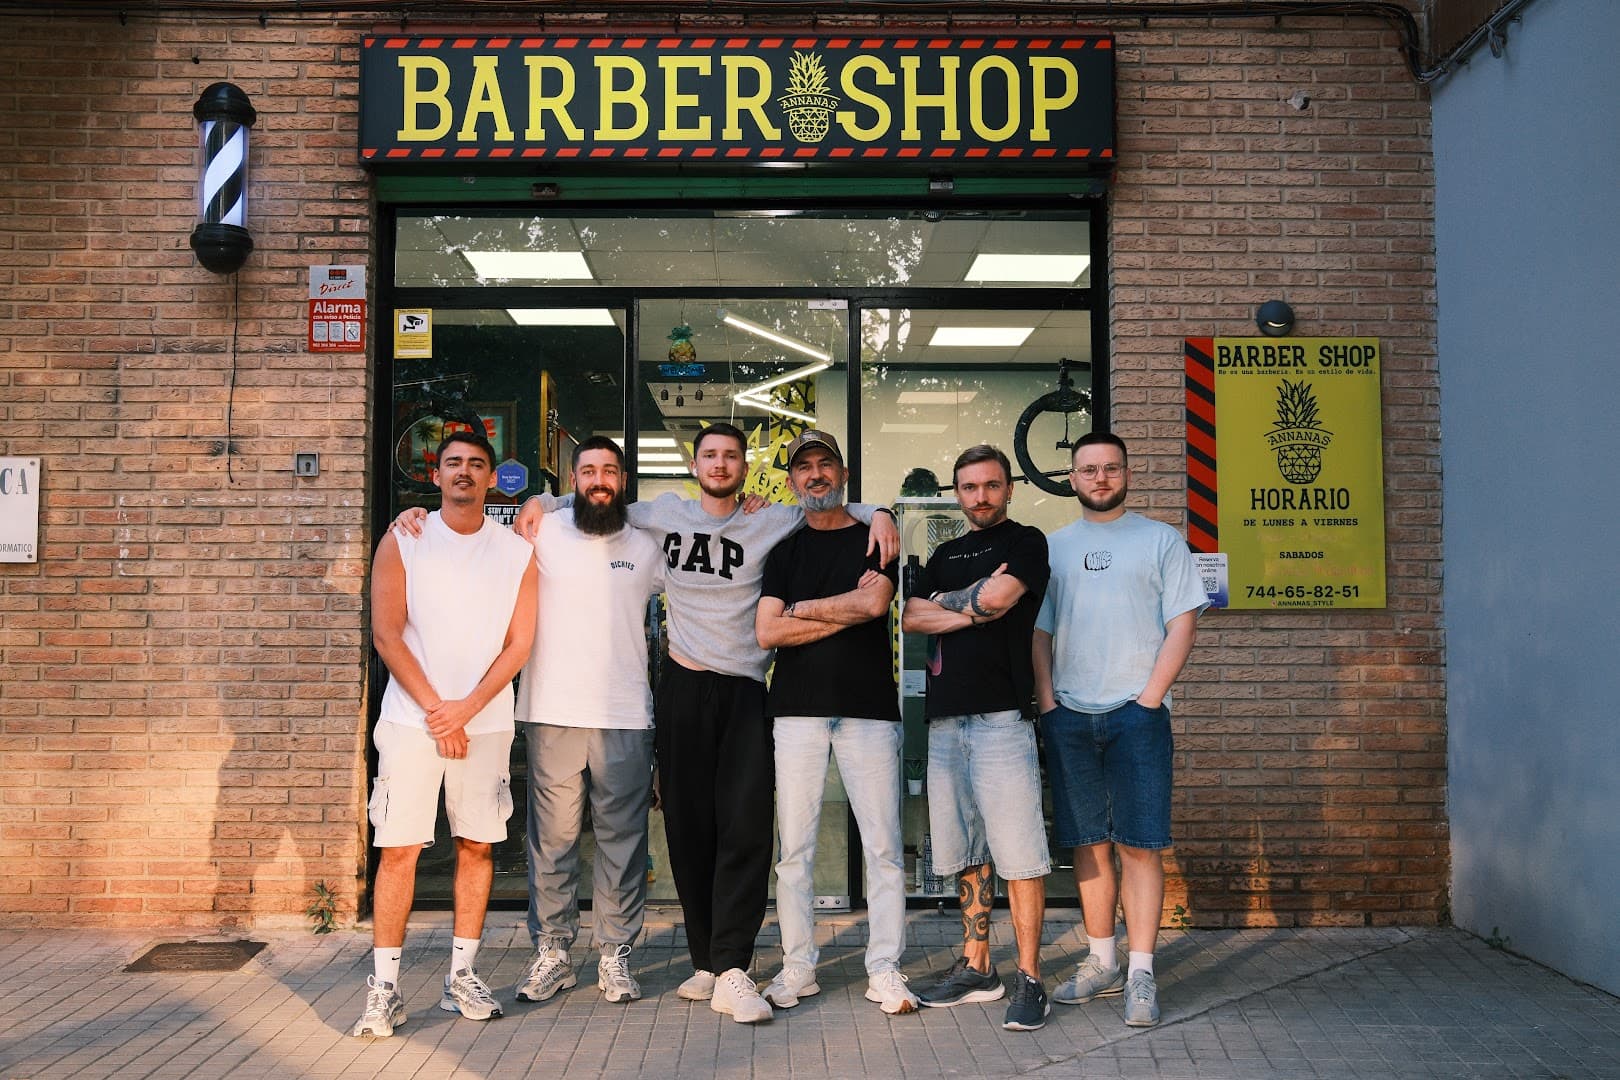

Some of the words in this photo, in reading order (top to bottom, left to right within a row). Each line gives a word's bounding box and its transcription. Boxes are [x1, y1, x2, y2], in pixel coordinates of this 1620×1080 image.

[397, 55, 781, 141] BARBER
[836, 54, 1078, 142] SHOP
[782, 96, 837, 110] ANNANAS
[313, 301, 361, 314] Alarma
[1217, 345, 1307, 368] BARBER
[1318, 345, 1376, 368] SHOP
[1269, 431, 1331, 446] ANNANAS
[1250, 488, 1350, 510] HORARIO
[1313, 518, 1358, 526] VIERNES
[662, 532, 744, 580] GAP
[1279, 551, 1324, 559] SABADOS
[610, 560, 635, 571] DICKIES
[1246, 585, 1359, 598] 744-65-82-51
